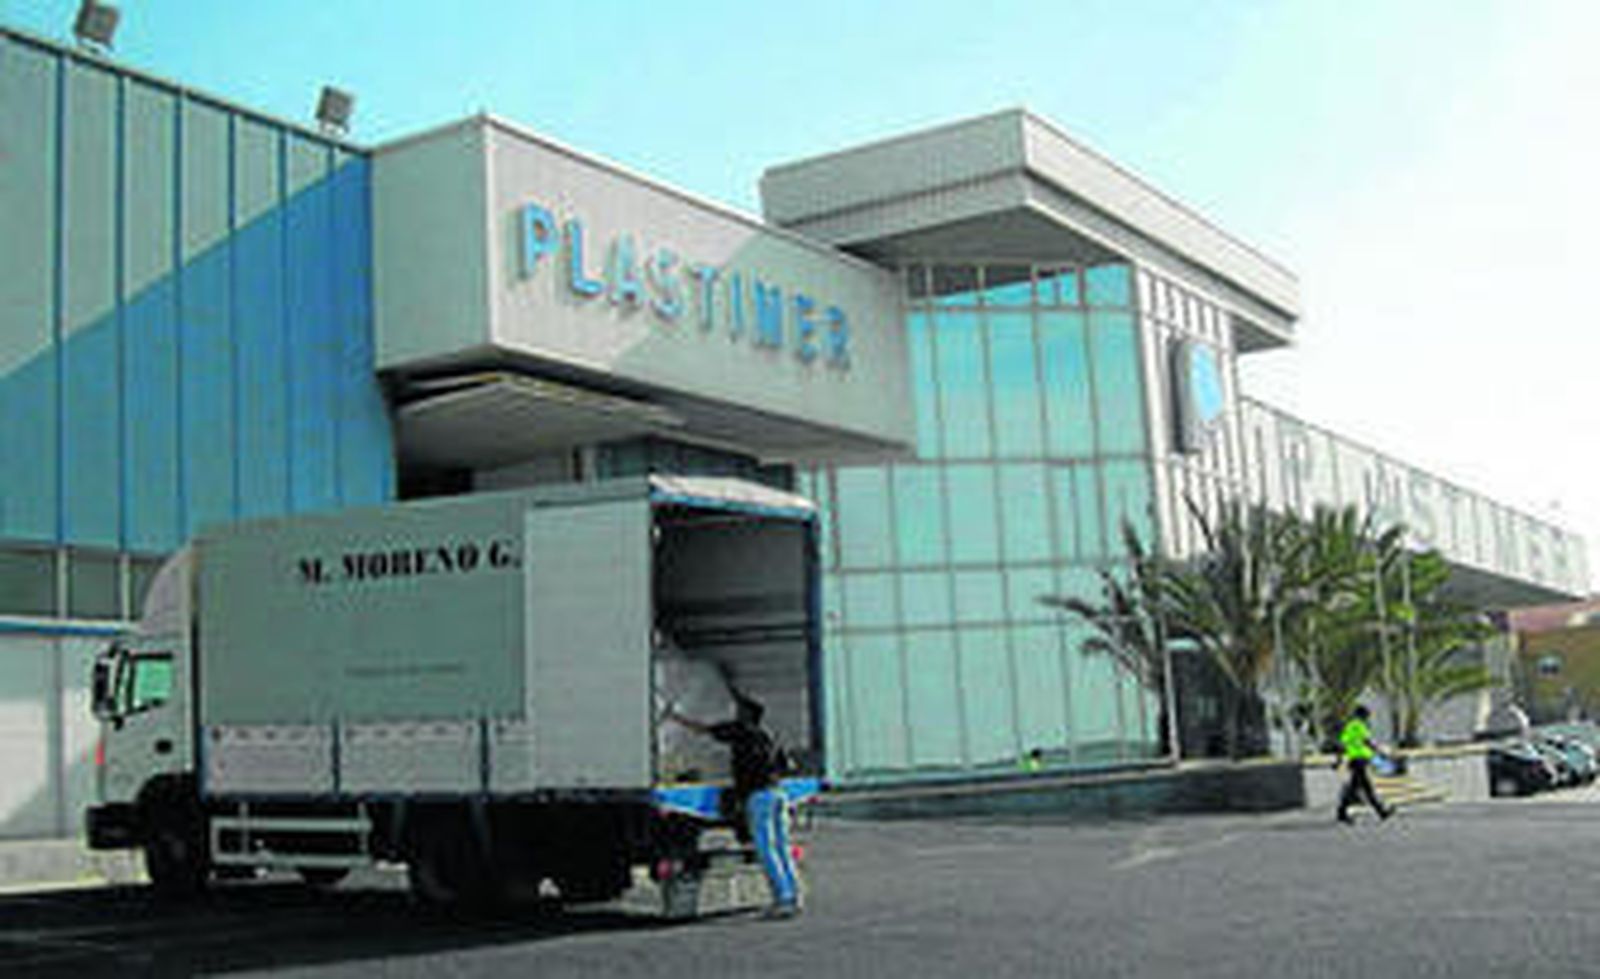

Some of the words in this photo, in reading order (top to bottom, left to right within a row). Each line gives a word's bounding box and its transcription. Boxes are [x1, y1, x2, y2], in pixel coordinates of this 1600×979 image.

[517, 202, 850, 369] PLASTIMER
[298, 557, 331, 584] M.
[342, 542, 479, 580] MORENO
[488, 540, 522, 569] G.
